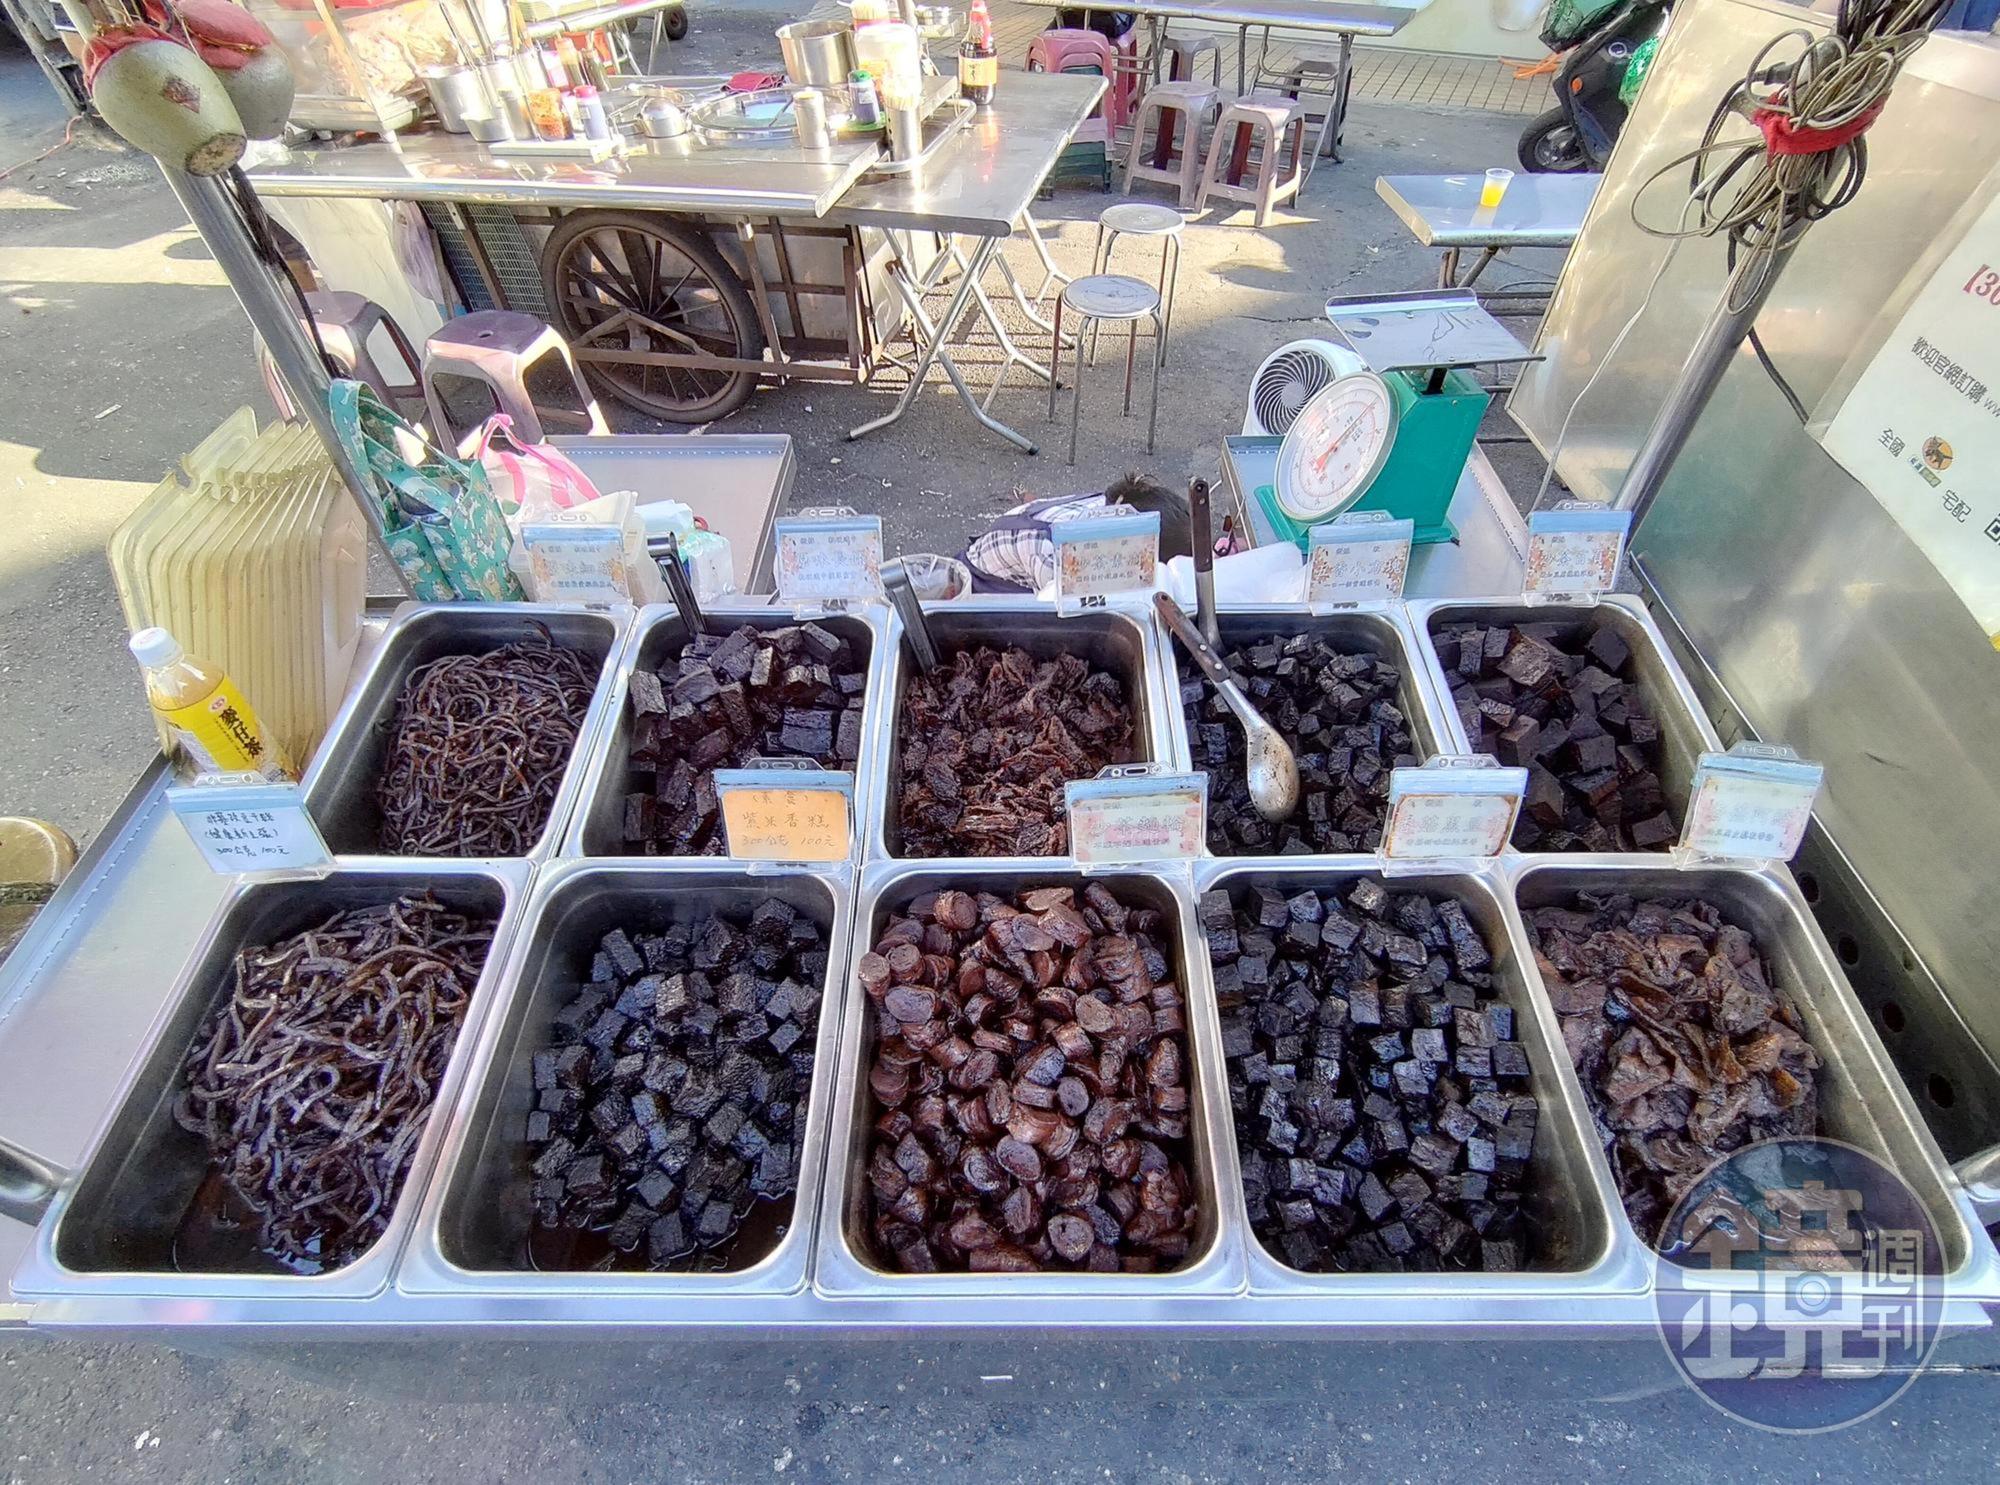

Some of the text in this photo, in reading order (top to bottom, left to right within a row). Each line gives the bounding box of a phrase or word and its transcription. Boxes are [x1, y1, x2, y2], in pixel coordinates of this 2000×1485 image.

[1912, 336, 1988, 406] 歡迎官網訂購
[1878, 428, 1972, 523] 全國 宅配
[742, 811, 829, 829] 紫米香糕
[742, 835, 836, 847] 300公克 100元
